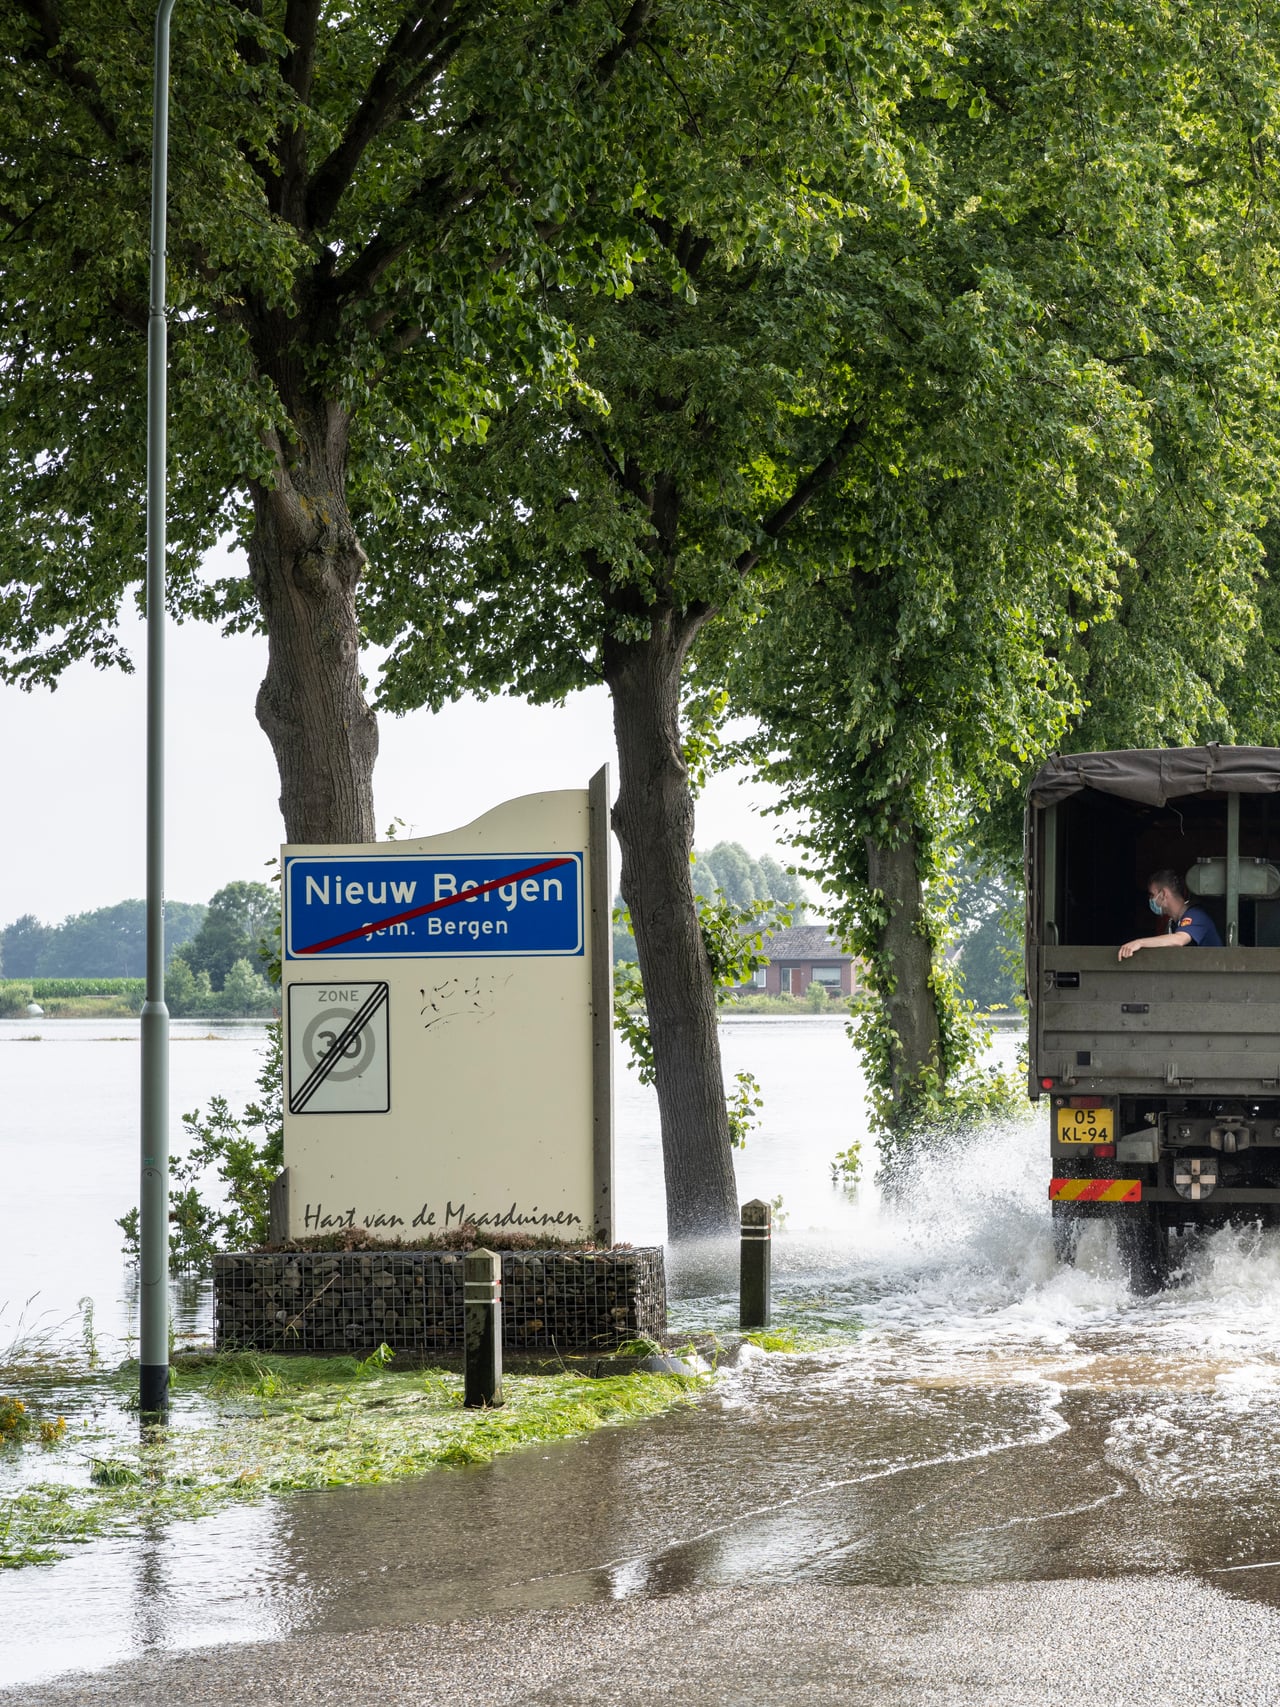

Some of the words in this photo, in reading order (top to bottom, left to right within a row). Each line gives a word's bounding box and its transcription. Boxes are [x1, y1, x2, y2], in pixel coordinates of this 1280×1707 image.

[305, 875, 417, 905] Nieuw
[433, 873, 563, 912] Bergen
[428, 917, 508, 940] Bergen
[318, 990, 359, 1002] ZONE
[1074, 1110, 1096, 1125] 05
[1062, 1127, 1108, 1142] KL-94
[304, 1203, 356, 1228] Hart
[363, 1212, 404, 1228] van
[412, 1203, 436, 1228] de
[445, 1201, 582, 1228] Maasduinen
